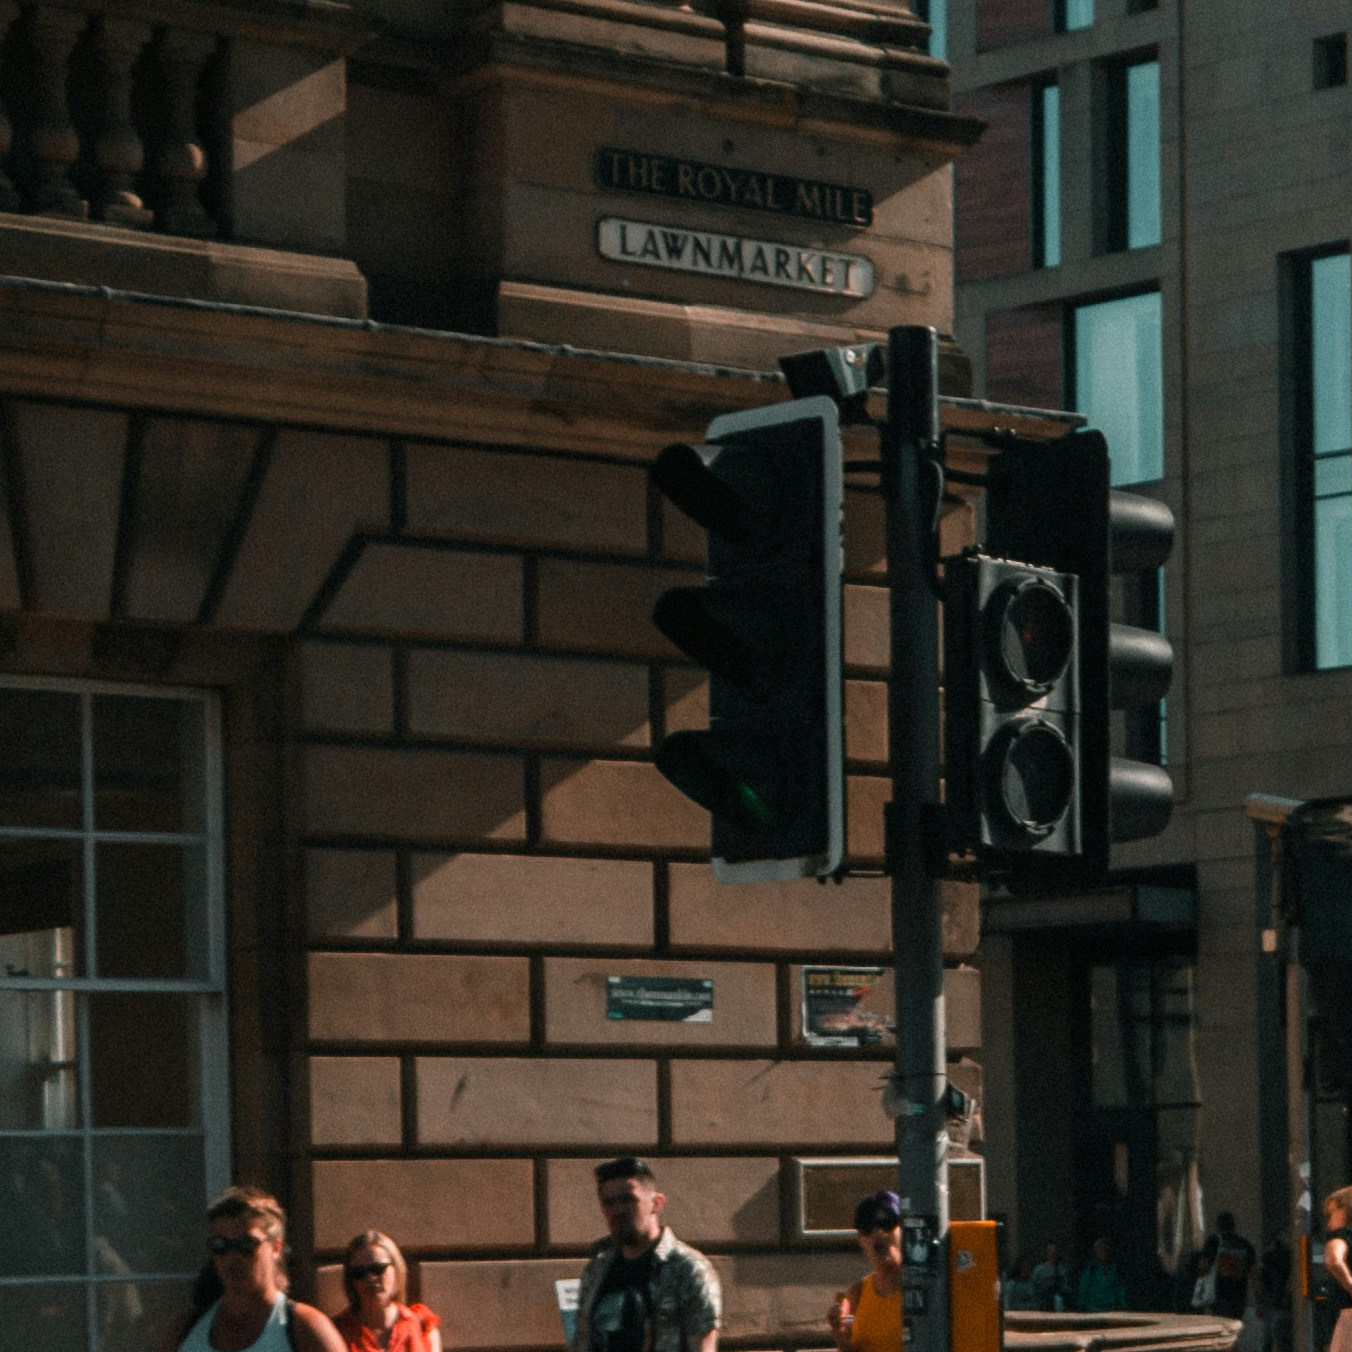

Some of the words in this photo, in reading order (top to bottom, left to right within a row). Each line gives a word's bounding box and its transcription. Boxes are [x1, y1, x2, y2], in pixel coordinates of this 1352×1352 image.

[611, 152, 667, 191] THE
[677, 164, 782, 208] ROYAL
[797, 182, 866, 224] MILE
[618, 223, 858, 290] LAWNMARKET
